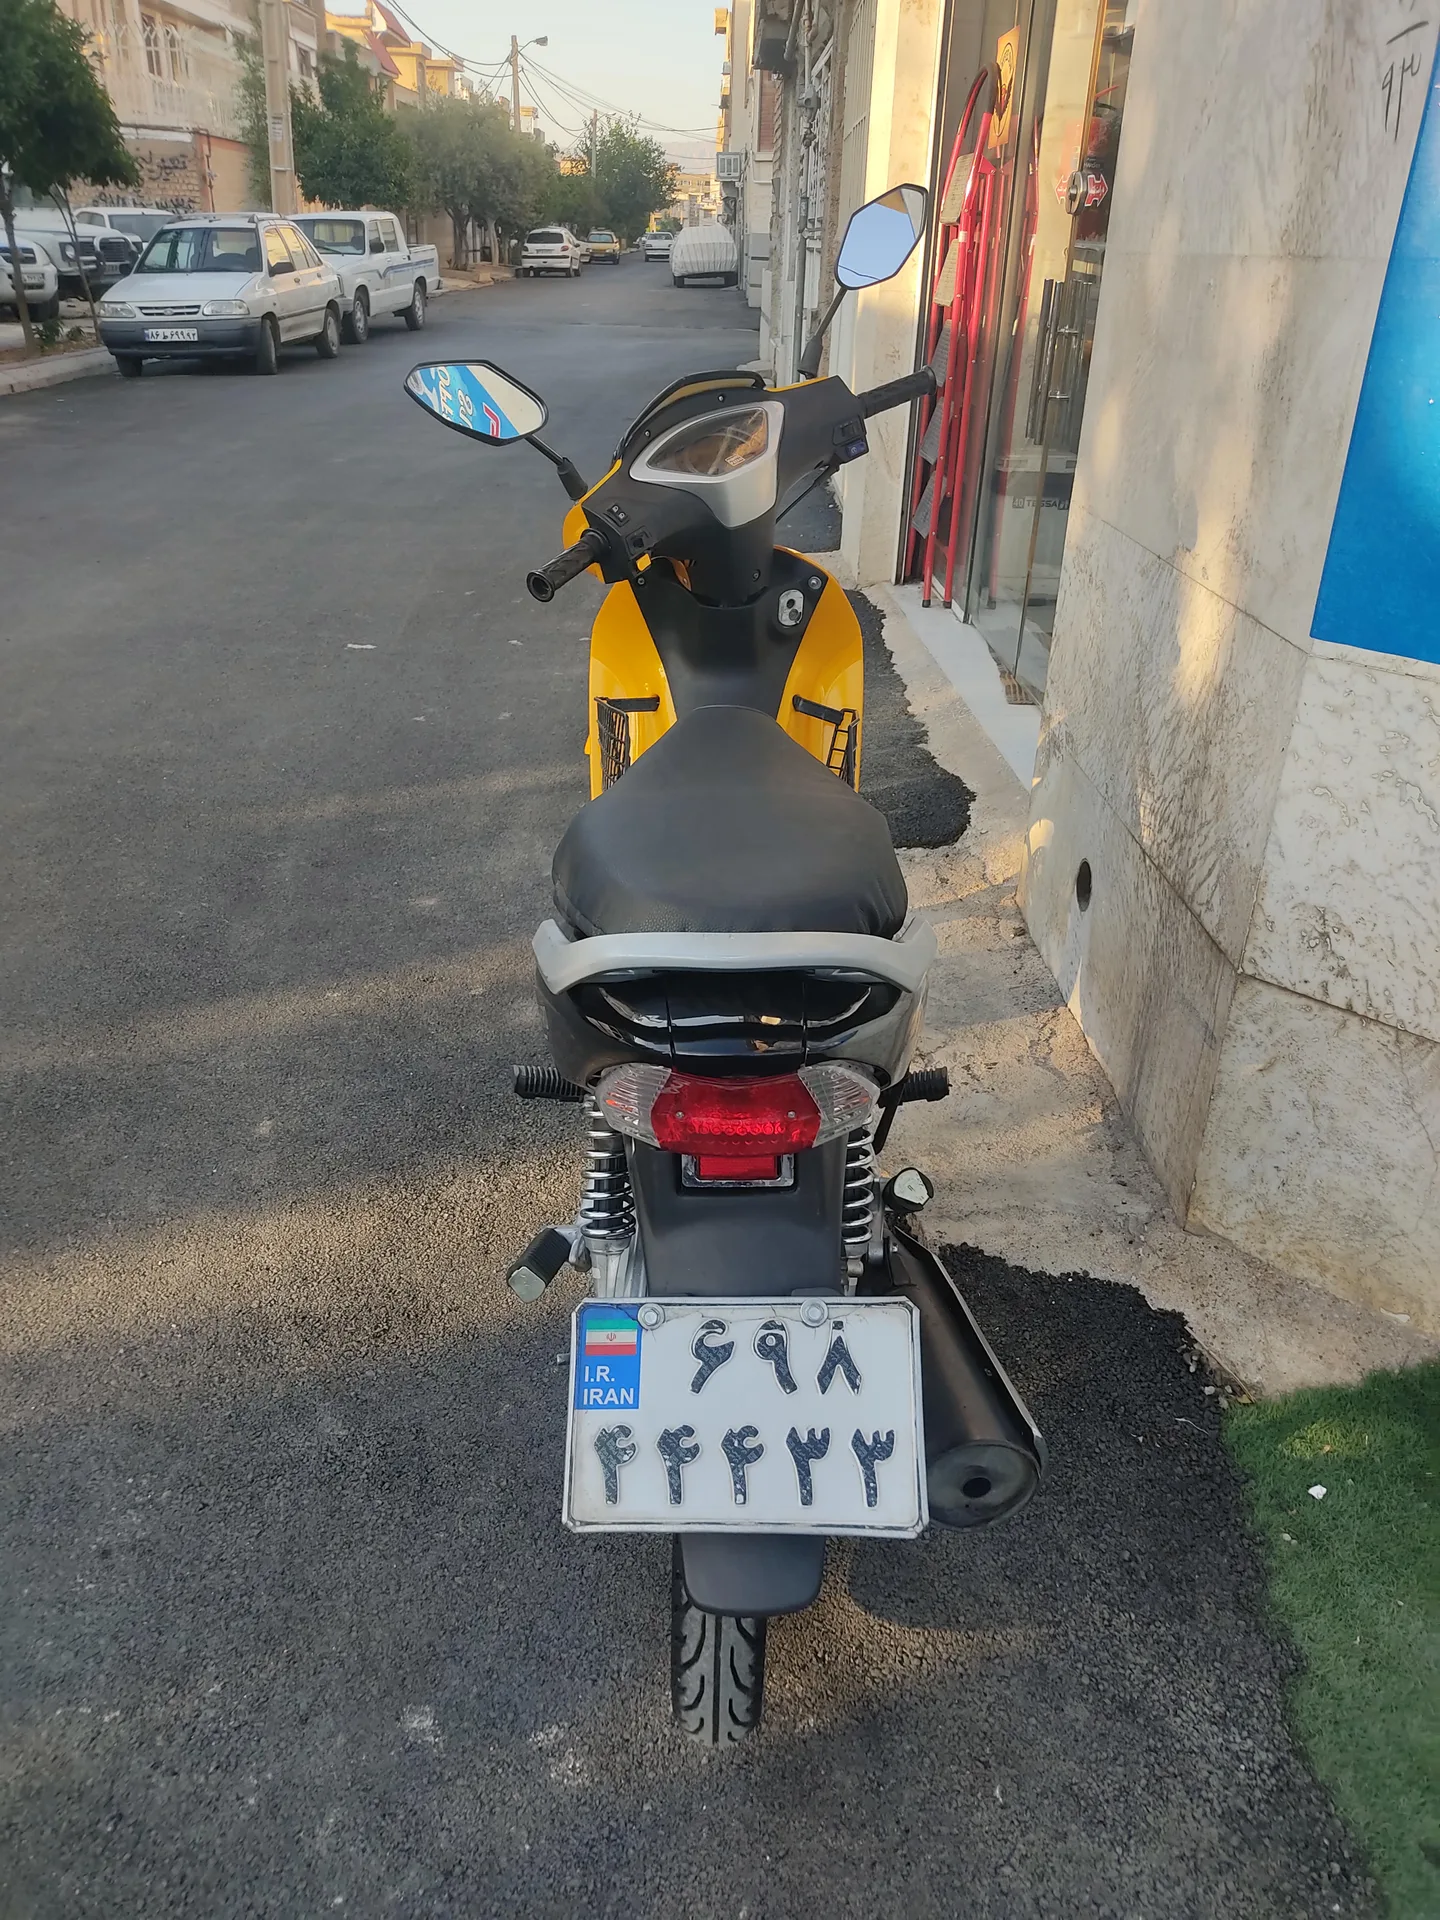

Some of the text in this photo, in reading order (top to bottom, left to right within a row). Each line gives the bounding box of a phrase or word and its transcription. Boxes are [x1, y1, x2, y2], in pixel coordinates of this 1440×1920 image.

[584, 1365, 615, 1382] I.R.
[689, 1318, 863, 1396] ۶۹۸
[583, 1387, 634, 1405] IRAN
[593, 1424, 896, 1508] ۴۴۴۳۳
